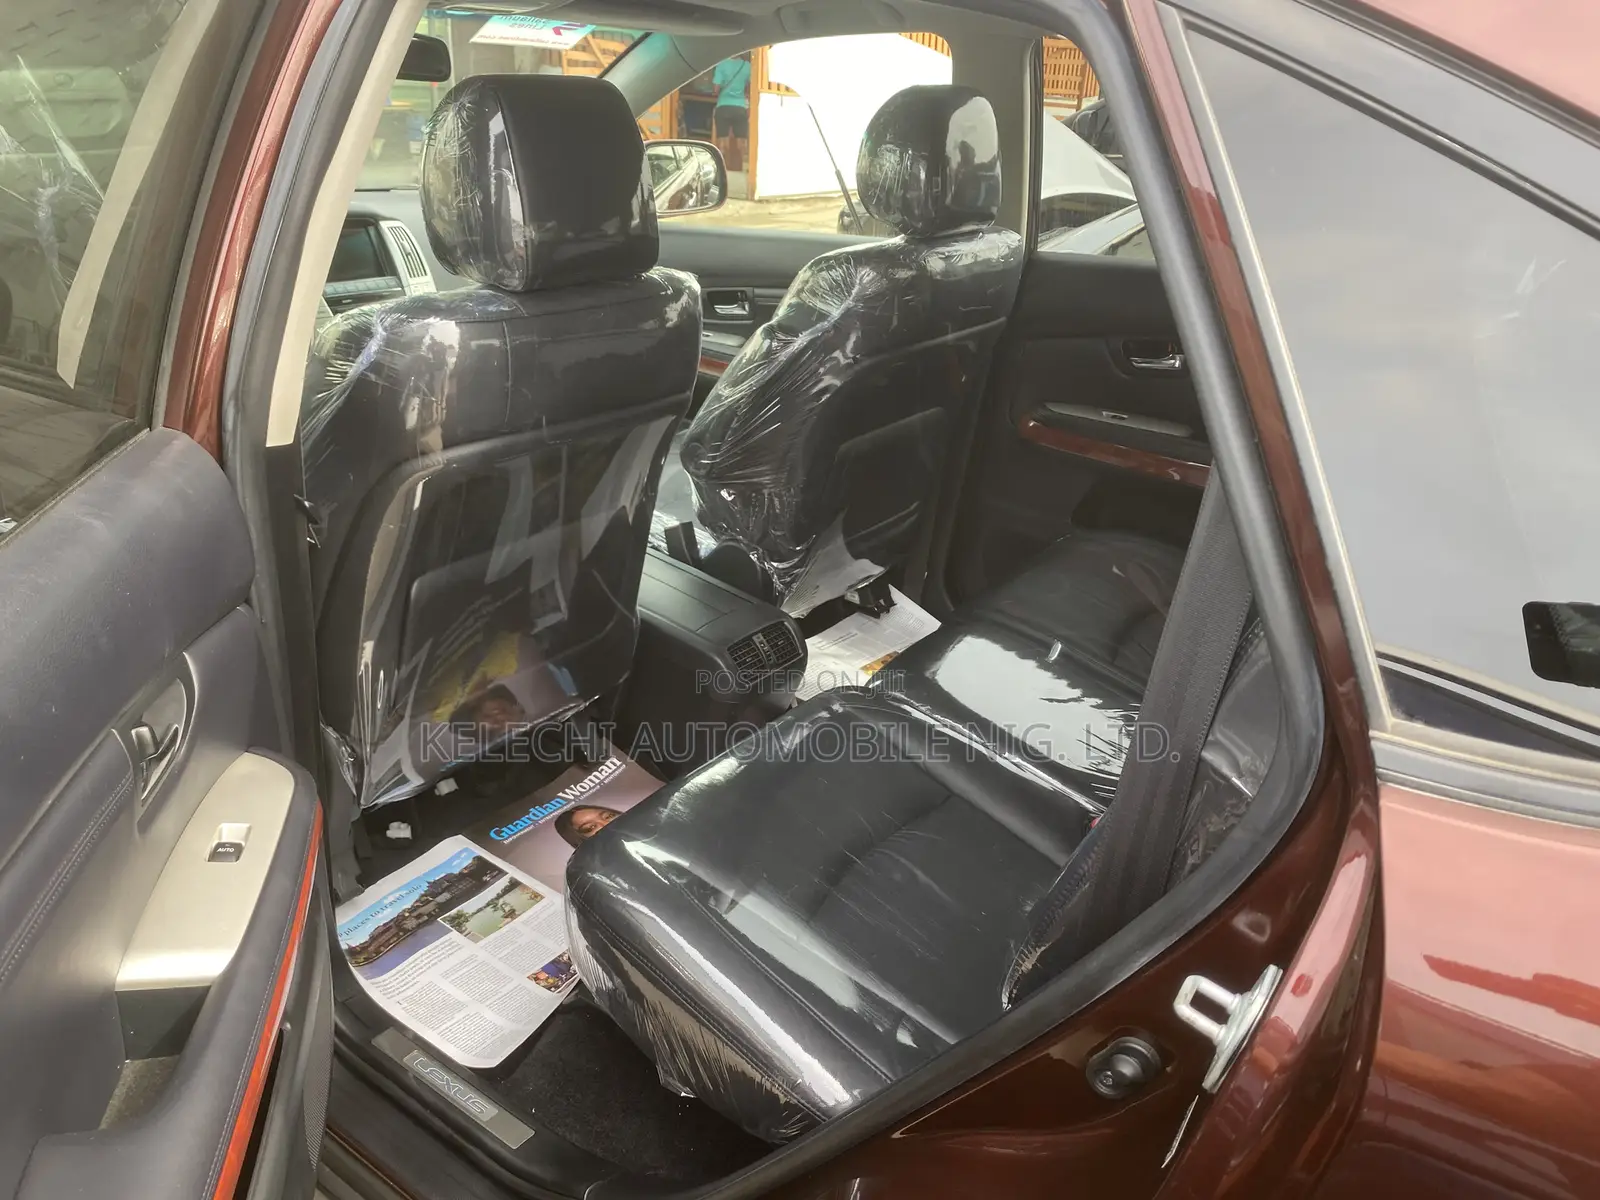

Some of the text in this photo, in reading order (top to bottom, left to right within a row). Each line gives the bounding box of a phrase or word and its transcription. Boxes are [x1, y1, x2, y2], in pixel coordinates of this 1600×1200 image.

[489, 757, 623, 841] Guardian Woman
[344, 916, 371, 937] places
[370, 909, 380, 919] to
[380, 894, 405, 912] travel
[405, 884, 422, 899] solo
[413, 1057, 490, 1115] LEXUS
